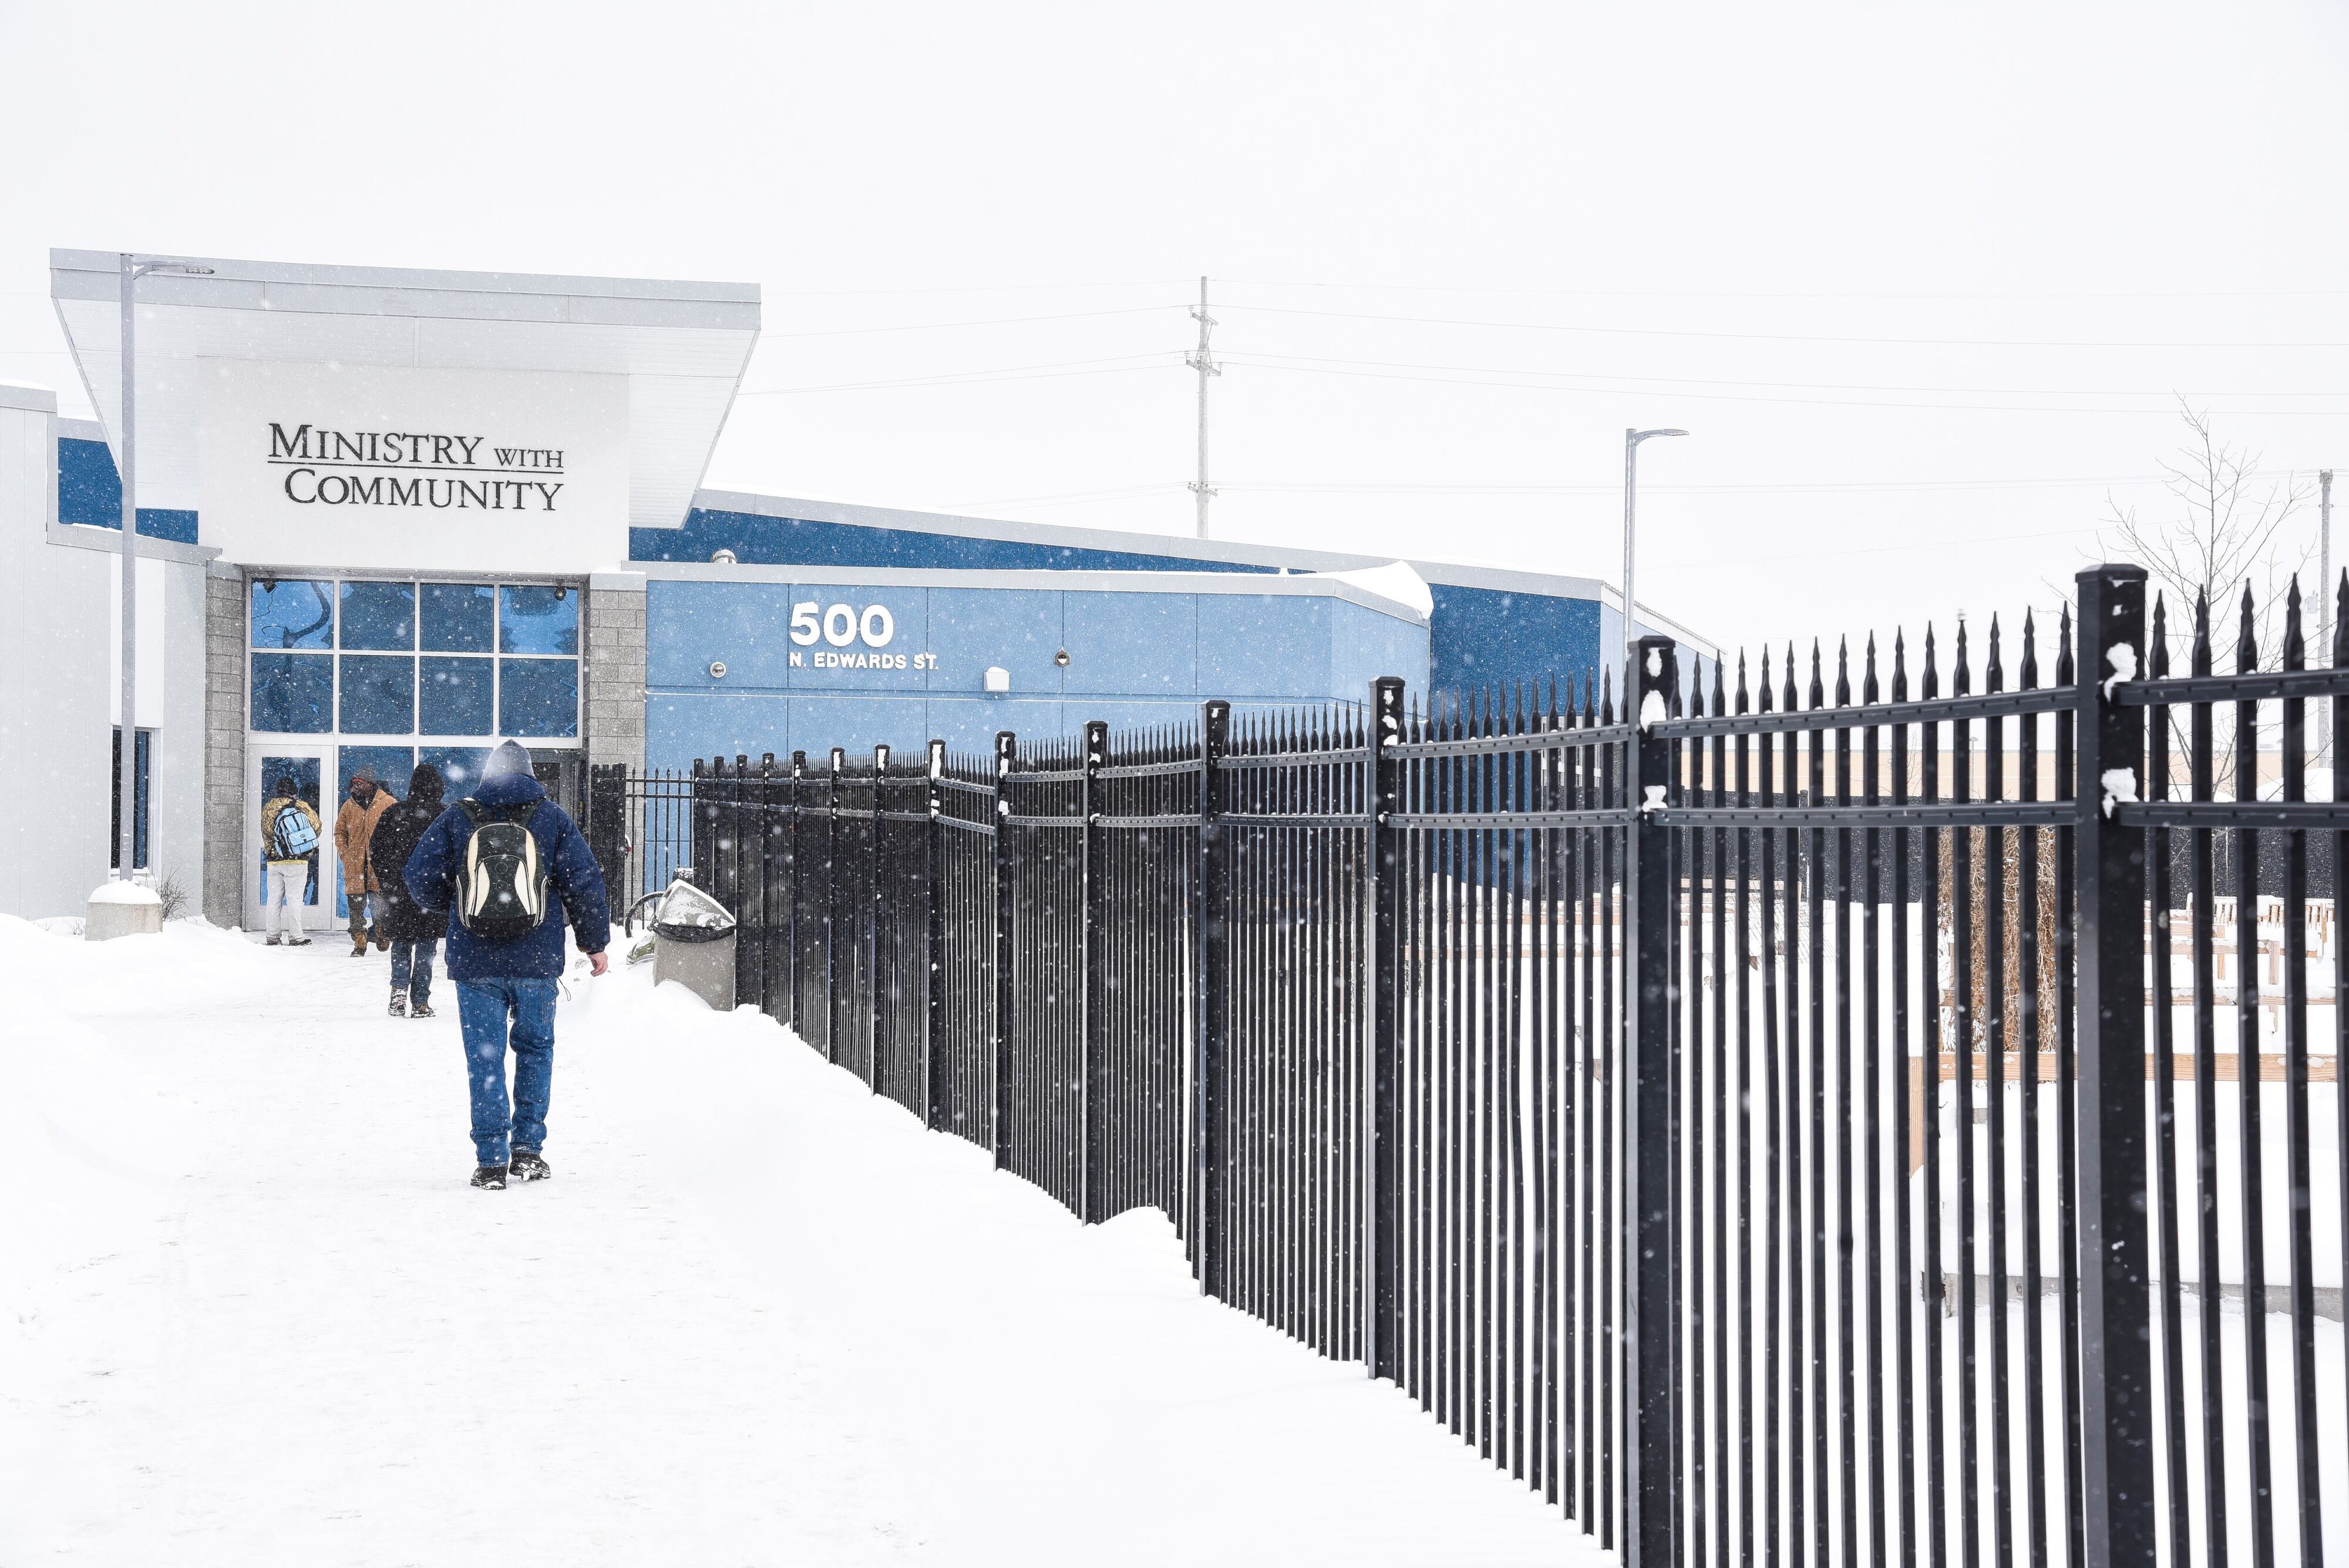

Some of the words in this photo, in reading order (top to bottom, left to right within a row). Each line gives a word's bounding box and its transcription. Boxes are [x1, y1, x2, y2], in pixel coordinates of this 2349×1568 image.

[268, 423, 484, 465] MINISTRY
[493, 448, 564, 468] WITH
[285, 468, 564, 510] COMMUNITY
[790, 601, 894, 648] 500
[789, 652, 806, 667] N.
[814, 652, 907, 669] EDWARDS
[913, 652, 939, 670] ST.
